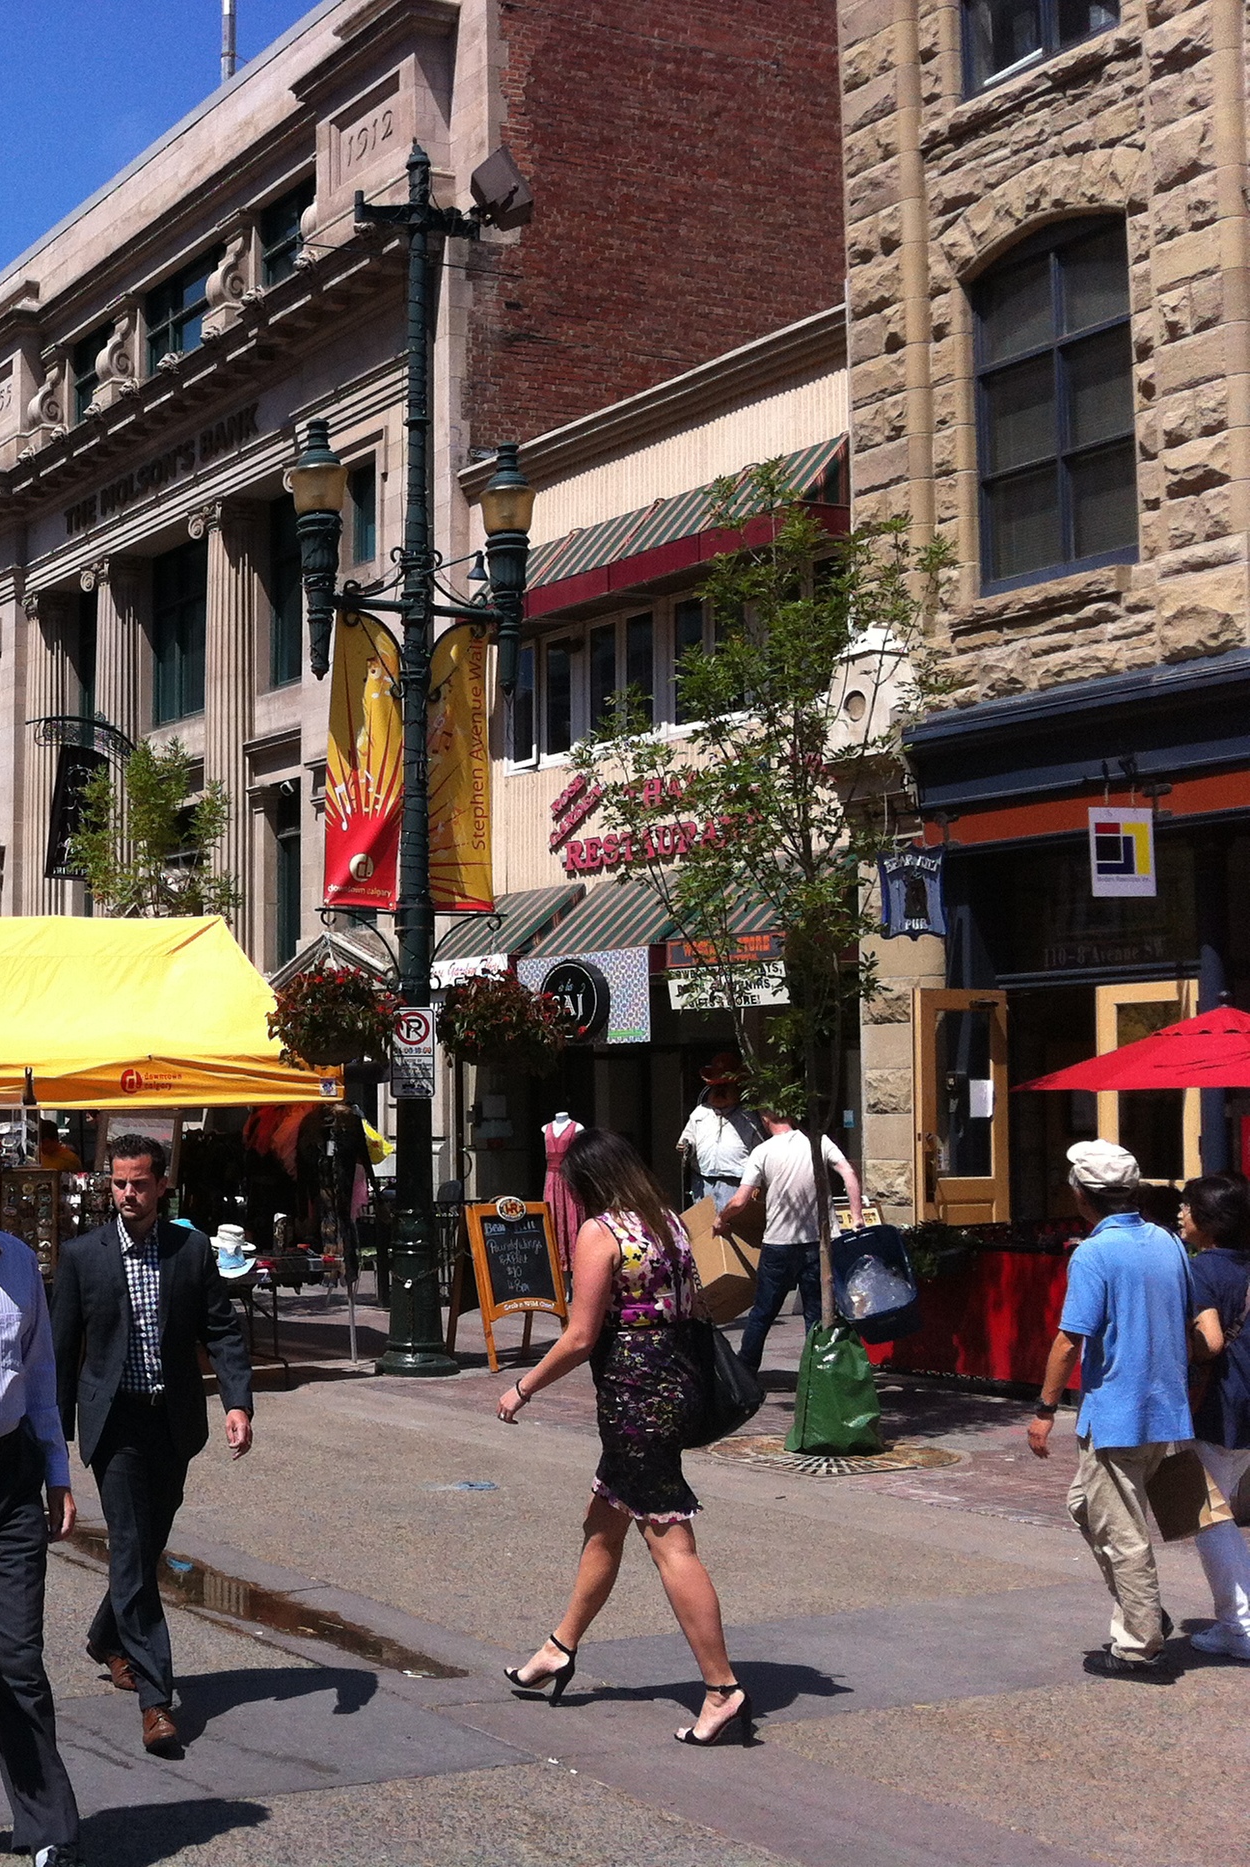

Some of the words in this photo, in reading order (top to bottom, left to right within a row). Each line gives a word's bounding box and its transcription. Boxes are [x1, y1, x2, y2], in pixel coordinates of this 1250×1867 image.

[347, 109, 393, 167] 1912
[63, 495, 97, 535] THE
[199, 402, 260, 460] BANK
[468, 686, 487, 763] Avenue
[469, 766, 488, 851] Stephen
[564, 808, 763, 871] RESTAURA
[905, 918, 930, 931] PUB
[723, 994, 761, 1007] ORE!
